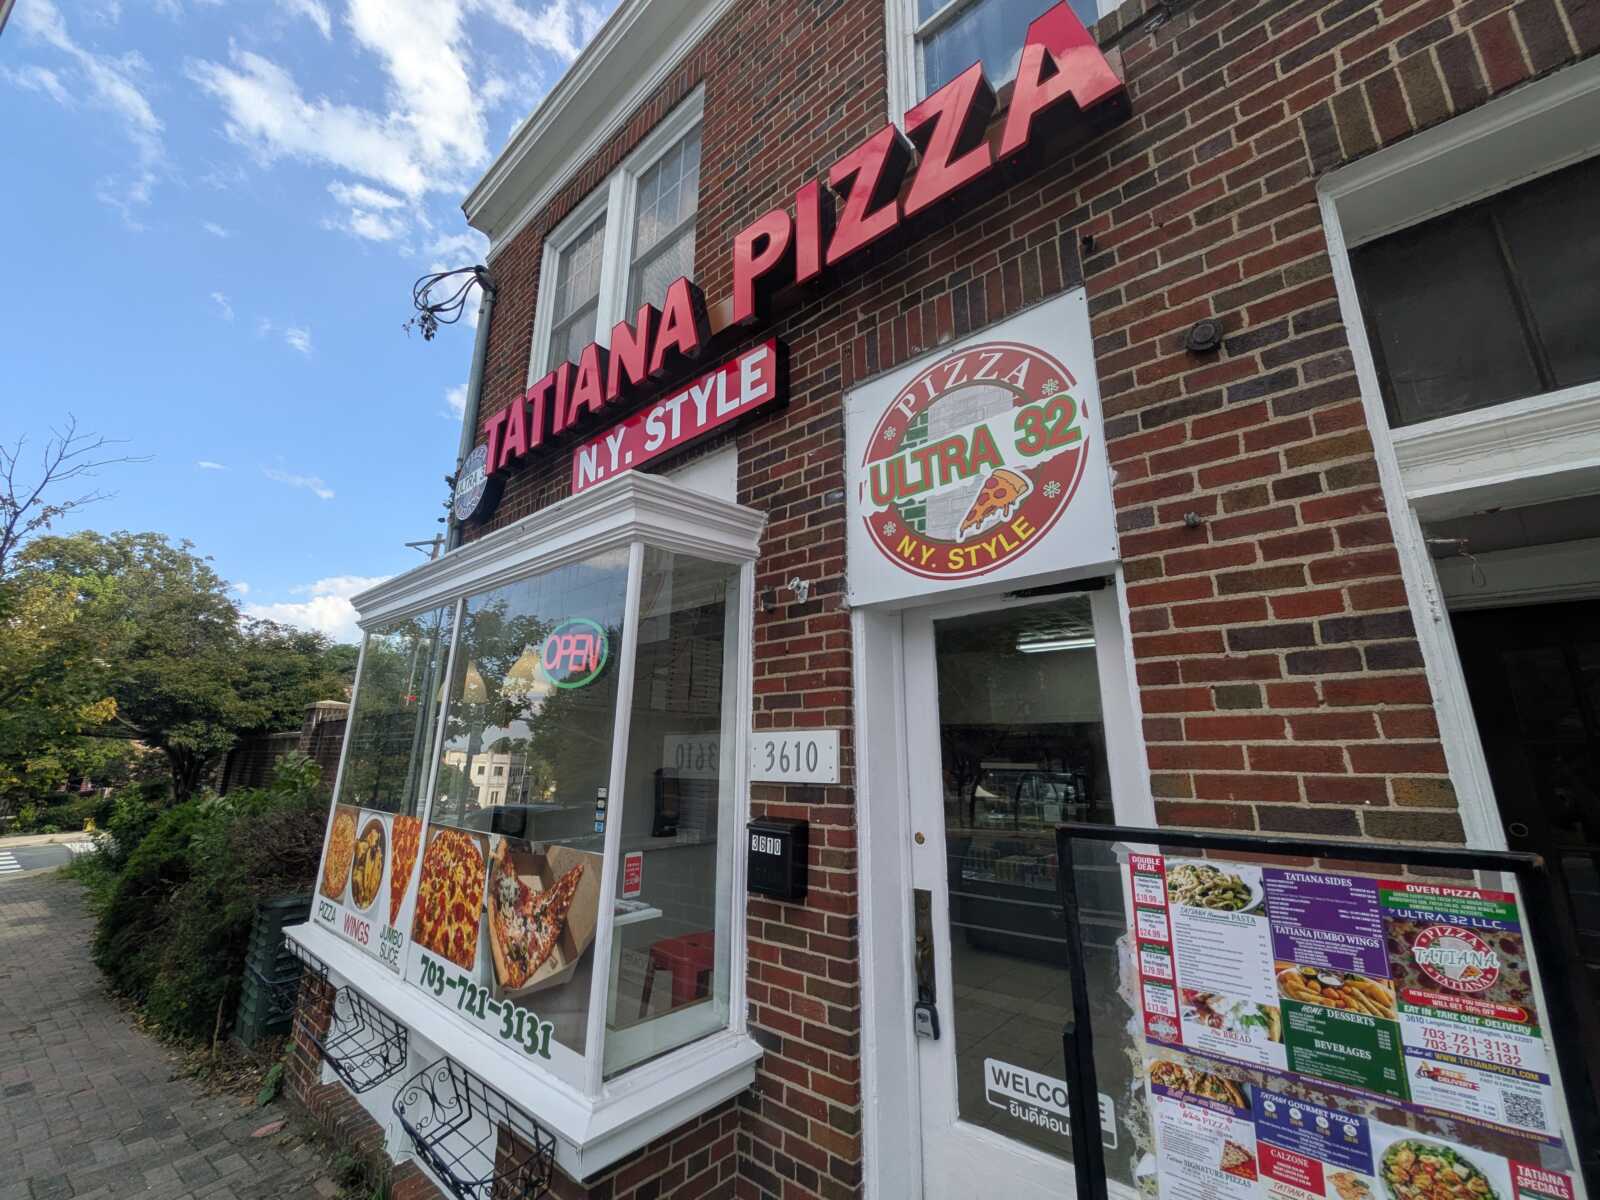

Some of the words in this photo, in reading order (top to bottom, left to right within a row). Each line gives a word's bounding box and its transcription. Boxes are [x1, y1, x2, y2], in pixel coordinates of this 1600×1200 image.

[484, 277, 701, 476] TATIANA
[732, 0, 1125, 326] PIZZA
[896, 351, 1031, 421] PIZZA
[577, 428, 632, 490] N.Y.
[644, 347, 768, 456] STYLE
[868, 423, 1005, 507] ULTRA
[1014, 393, 1082, 457] 32
[896, 535, 937, 569] N.Y.
[948, 516, 1036, 570] STYLE
[543, 633, 601, 673] OPEN
[764, 740, 818, 773] 3610
[752, 835, 781, 855] 3610
[1131, 856, 1161, 865] DOUBLE
[1137, 863, 1157, 872] DEAL
[1284, 872, 1324, 884] TATIANA
[1325, 878, 1353, 887] SIDES
[1406, 884, 1440, 895] OVEN
[1443, 888, 1481, 899] PIZZA
[320, 900, 337, 925] PIZZA
[1231, 914, 1257, 924] PASTA
[1398, 909, 1447, 922] ULTRA
[1450, 915, 1468, 925] 32
[1472, 918, 1507, 930] LLC.
[343, 912, 370, 945] WINGS
[380, 924, 404, 948] JUMBO
[1274, 925, 1312, 937] TATIANA
[1313, 931, 1345, 943] JUMBO
[1346, 936, 1379, 948] WINGS
[1425, 927, 1478, 946] PIZZA
[379, 942, 399, 966] SLICE
[1414, 948, 1498, 968] TATIANA
[1433, 973, 1491, 991] TATIANA
[420, 955, 553, 1059] 703-721-3131
[1432, 1000, 1448, 1008] WILL
[1327, 1009, 1376, 1026] DESSERTS
[1404, 1005, 1421, 1013] EAT
[1422, 1007, 1432, 1015] IN
[1436, 1010, 1460, 1021] TAKE
[1461, 1014, 1481, 1024] OUT
[1485, 1018, 1532, 1035] DELIVERY
[1223, 1031, 1252, 1043] BREAD
[1422, 1027, 1520, 1055] 703-721-3131
[1314, 1039, 1372, 1060] BEVERAGES
[1424, 1038, 1522, 1066] 703-721-3132
[992, 1066, 1107, 1122] WELCOE
[1437, 1077, 1474, 1089] DELIVERY
[1009, 1100, 1070, 1137] ยินดีต้อน
[1288, 1100, 1329, 1118] GOURMET
[1330, 1112, 1360, 1126] PIZZAS
[1270, 1149, 1309, 1168] CALZONE
[1516, 1165, 1566, 1187] TATIANA
[1517, 1176, 1569, 1199] SPECIALS
